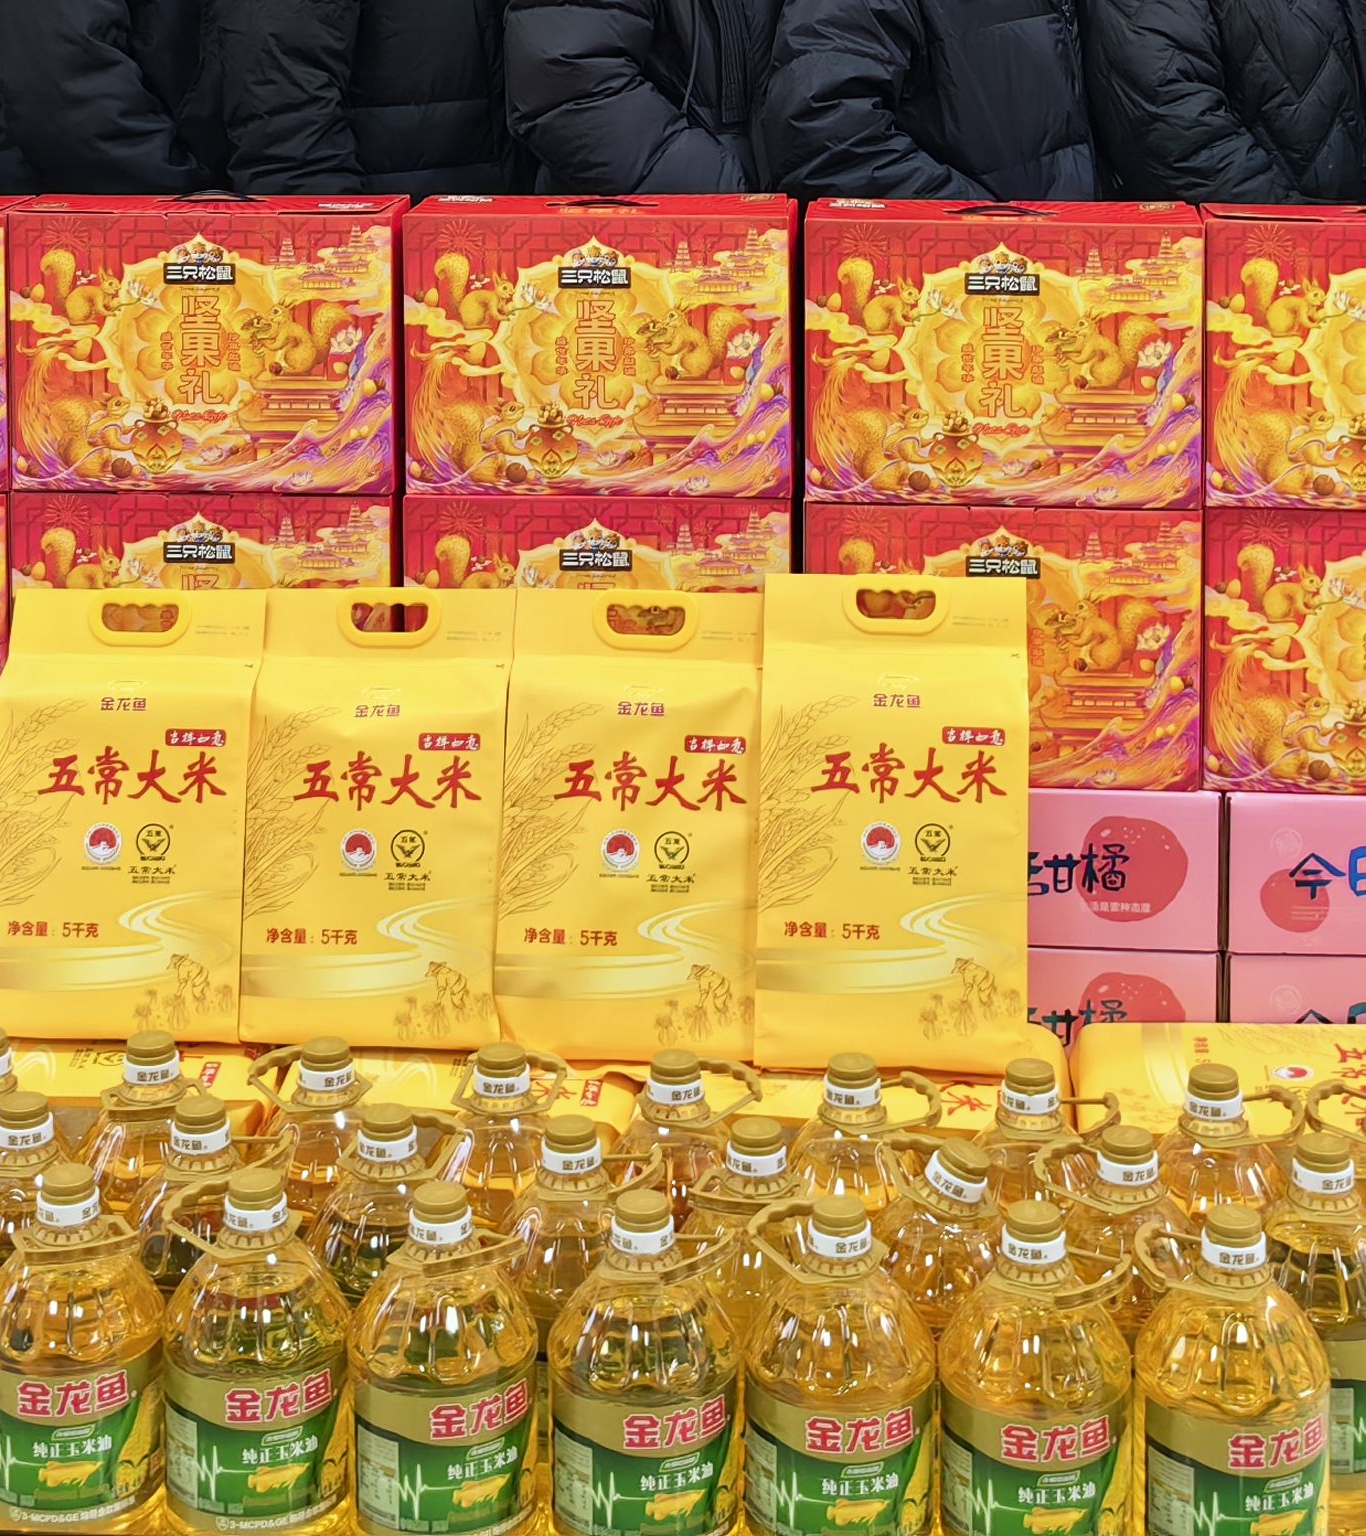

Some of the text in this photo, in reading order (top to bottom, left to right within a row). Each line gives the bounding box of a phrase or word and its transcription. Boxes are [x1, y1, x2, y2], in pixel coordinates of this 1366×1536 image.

[166, 265, 233, 281] 三只松鼠
[561, 269, 628, 285] 三只松鼠
[967, 275, 1037, 292] 三只松鼠
[179, 295, 225, 404] 坚果礼
[574, 300, 620, 409] 坚果礼
[981, 307, 1028, 418] 坚果礼
[166, 544, 233, 560] 三只松鼠
[563, 552, 629, 568] 三只松鼠
[969, 558, 1037, 574] 三只松鼠
[100, 697, 147, 712] 金龙鱼
[355, 705, 400, 718] 金龙鱼
[618, 701, 665, 716] 金龙鱼
[873, 694, 920, 708] 金龙鱼
[170, 731, 224, 746] 吉祥如意
[423, 735, 479, 751] 吉祥如意
[688, 737, 744, 755] 吉祥如意
[946, 729, 1003, 746] 吉祥如意
[37, 746, 227, 805] 五常大米
[294, 751, 482, 811] 五常大米
[554, 751, 747, 812] 五常大米
[811, 743, 1007, 803] 五常大米
[137, 1069, 169, 1082] 金龙鱼
[483, 1082, 516, 1094] 金龙鱼
[8, 1132, 42, 1146] 金龙鱼
[562, 1158, 596, 1171] 金龙鱼
[1122, 1168, 1154, 1182] 金龙鱼
[934, 1171, 965, 1198] 金龙鱼
[1009, 1244, 1042, 1260] 金龙鱼
[1219, 1252, 1255, 1264] 金龙鱼
[17, 1370, 127, 1417] 金龙鱼
[224, 1369, 331, 1424] 金龙鱼
[429, 1378, 528, 1440] 金龙鱼
[622, 1394, 727, 1449] 金龙鱼
[805, 1406, 914, 1454] 金龙鱼
[33, 1434, 112, 1458] 纯正玉米油
[1000, 1414, 1109, 1462] 金龙鱼
[1228, 1414, 1325, 1468] 金龙鱼
[242, 1436, 318, 1464] 纯正玉米油
[447, 1446, 518, 1480] 纯正玉米油
[640, 1462, 714, 1492] 纯正玉米油
[822, 1472, 899, 1496] 纯正玉米油
[1018, 1481, 1097, 1504] 纯正玉米油
[1245, 1482, 1314, 1512] 纯正玉米油
